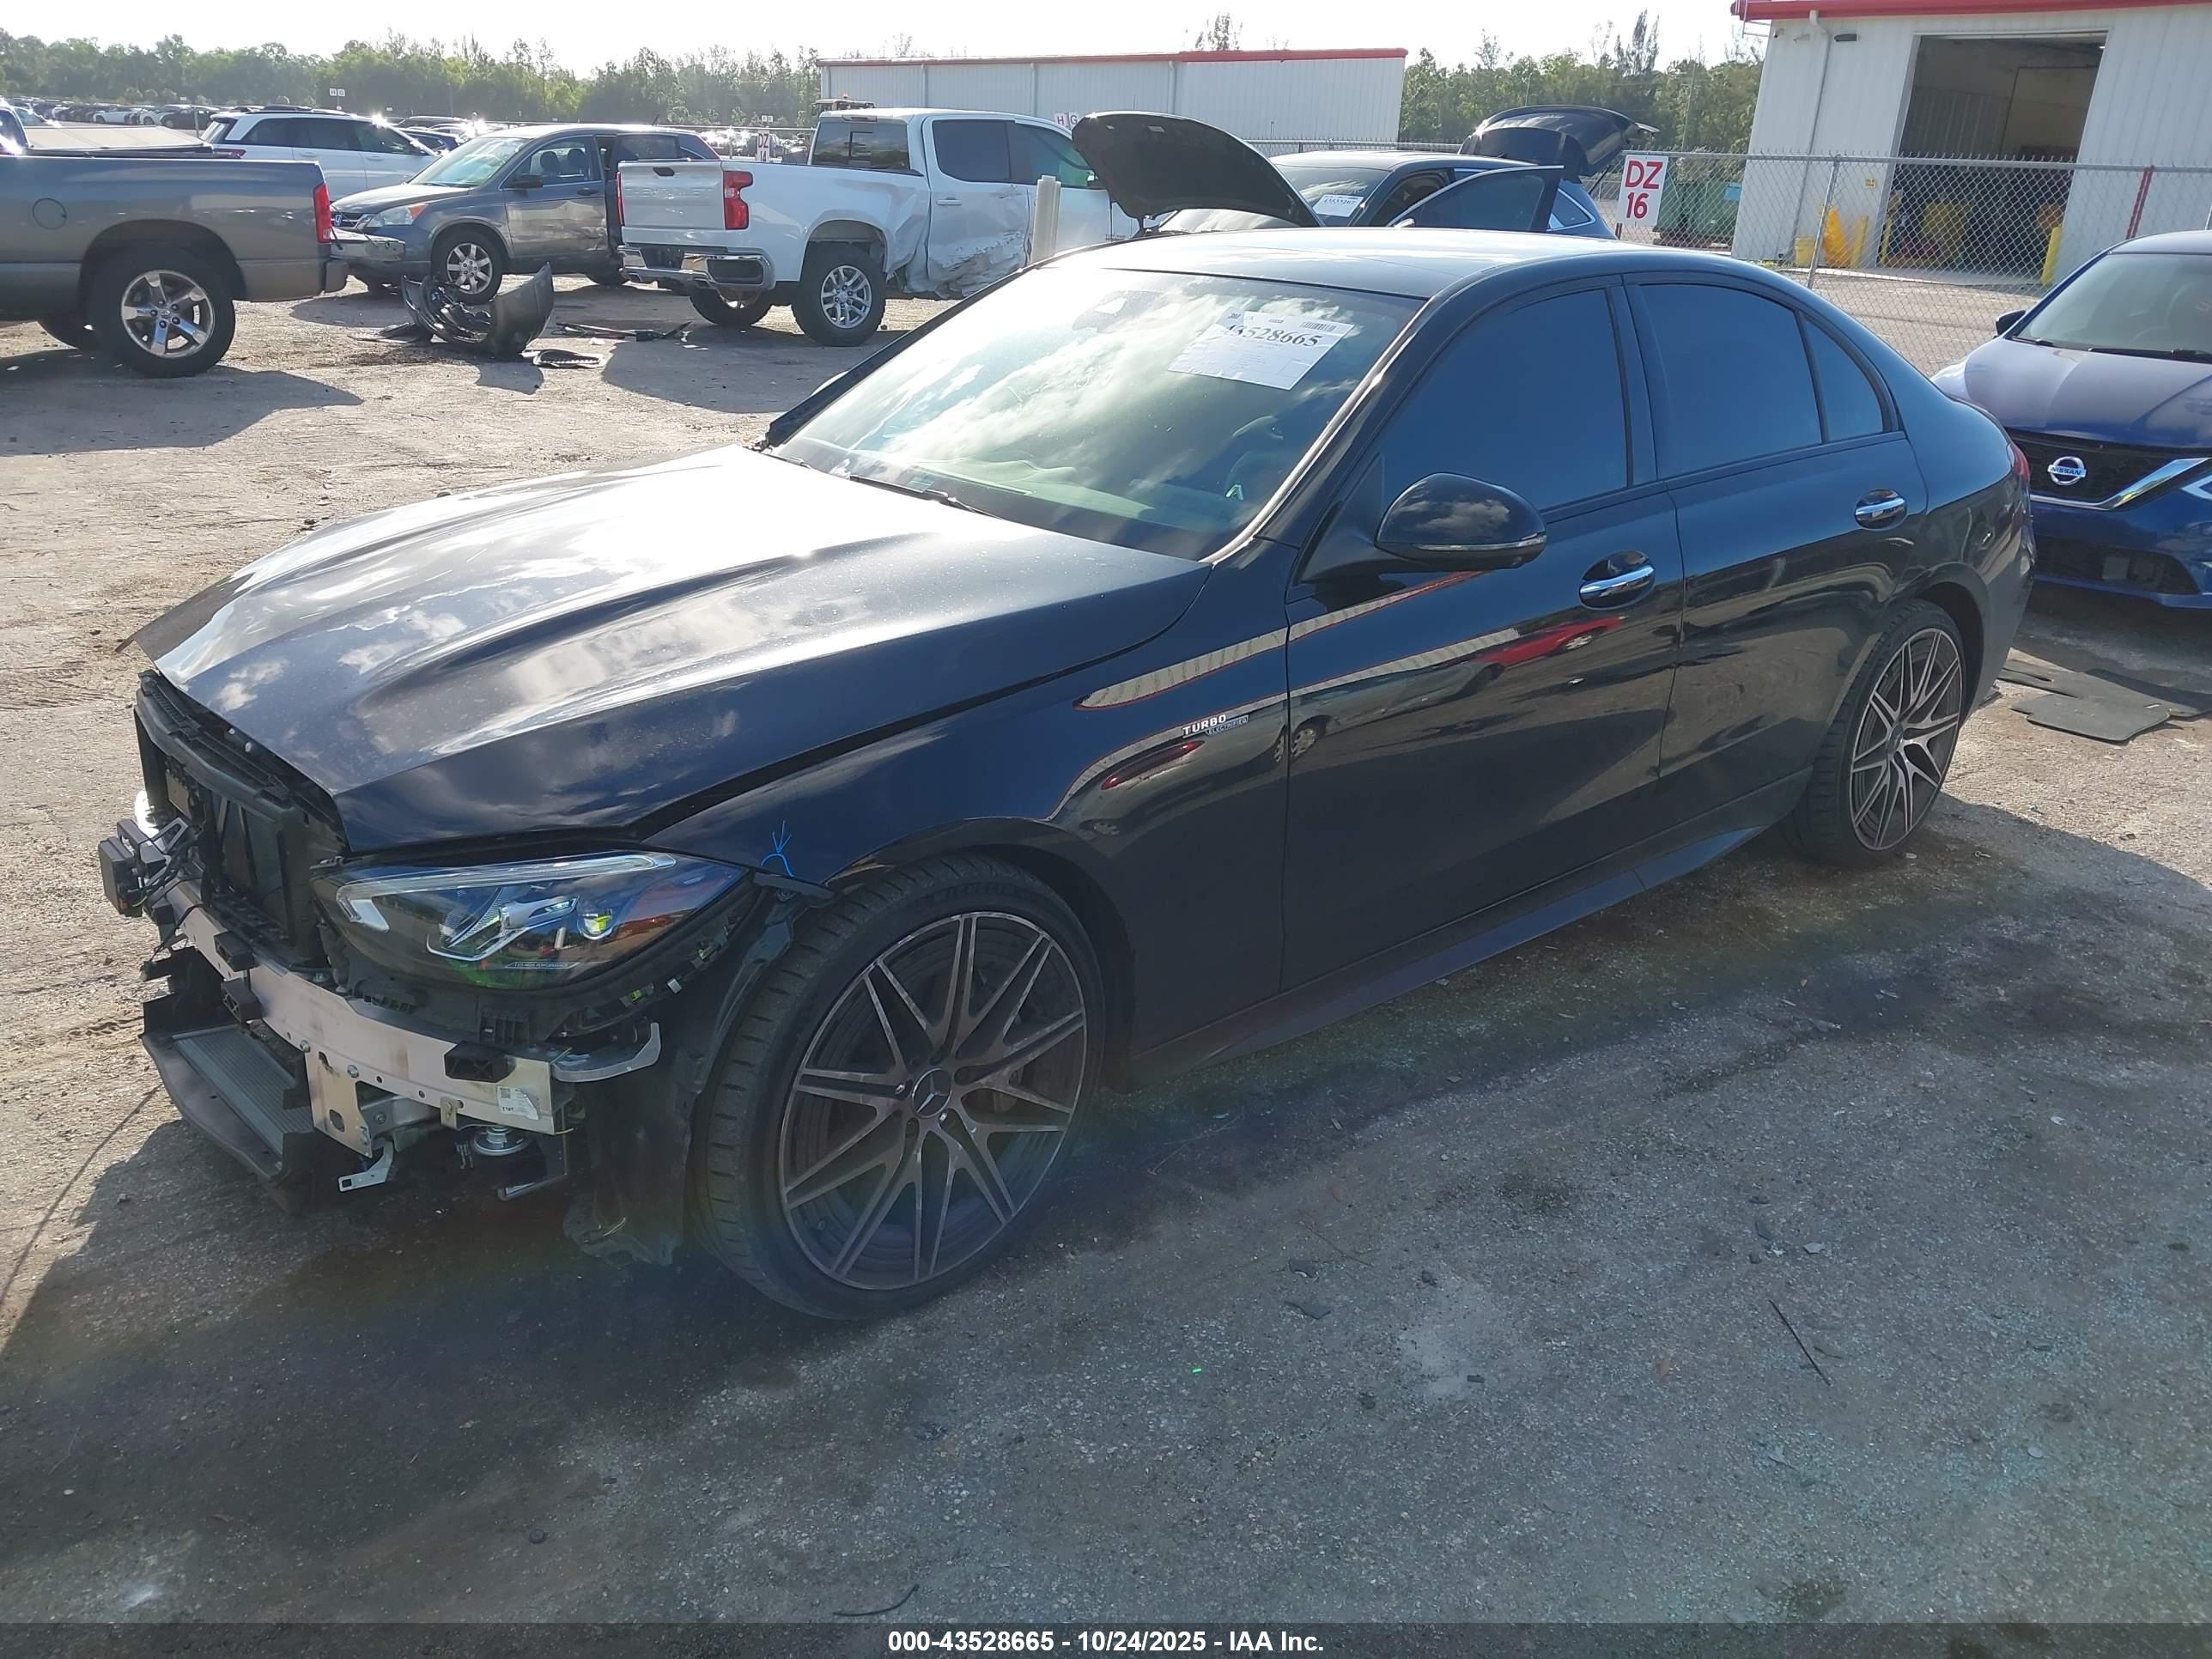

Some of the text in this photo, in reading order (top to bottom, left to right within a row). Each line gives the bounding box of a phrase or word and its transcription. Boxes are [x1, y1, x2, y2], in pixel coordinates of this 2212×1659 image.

[1057, 114, 1078, 125] H G
[758, 133, 769, 149] DZ
[1625, 160, 1663, 189] DZ
[1626, 191, 1649, 219] 16
[2051, 466, 2082, 476] NISSAN
[1182, 714, 1226, 736] TURBO
